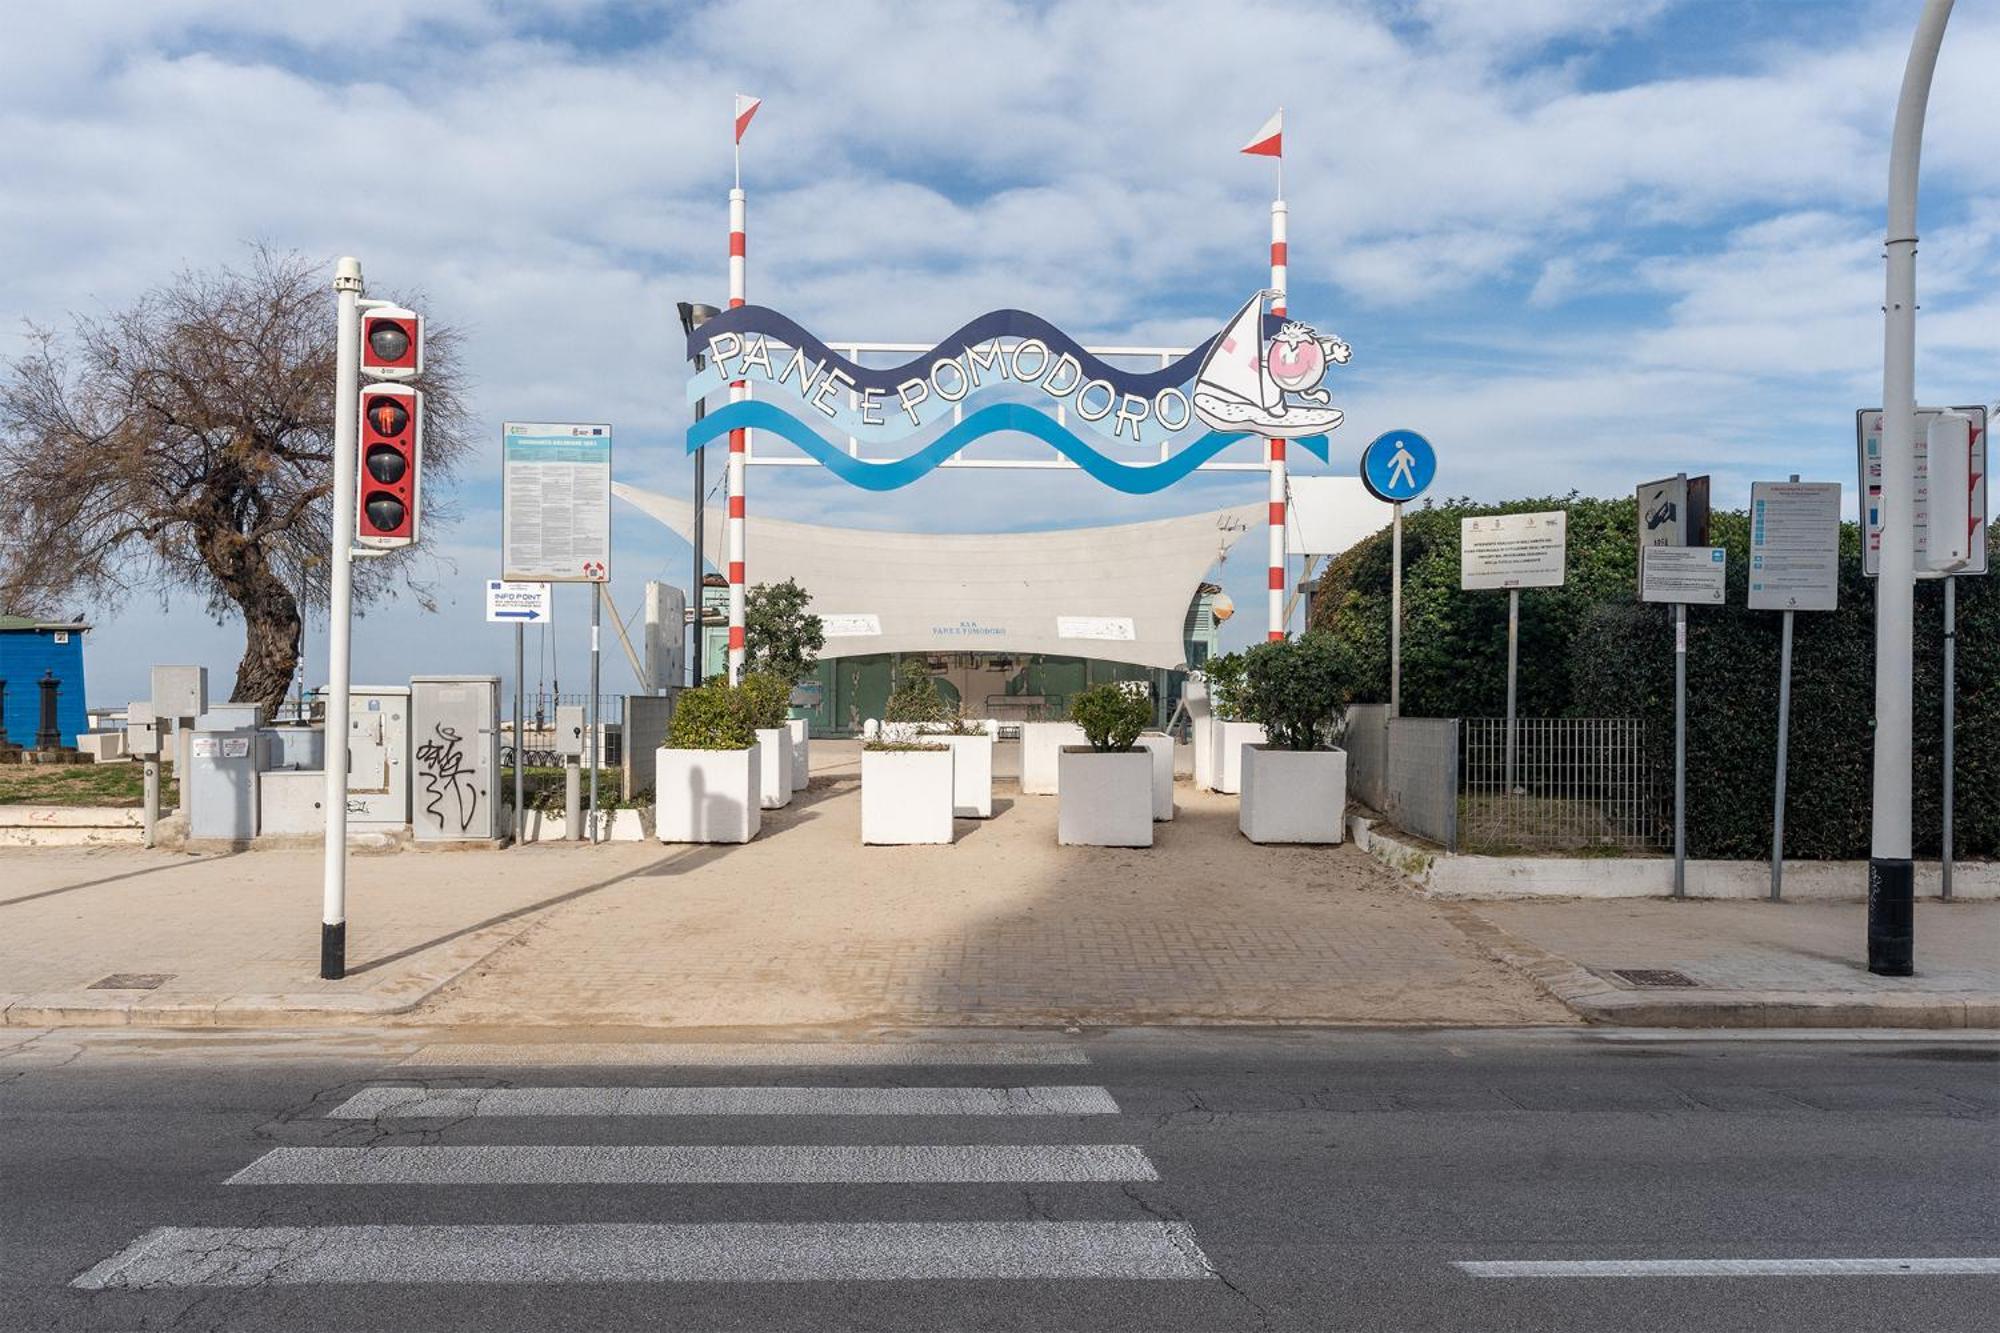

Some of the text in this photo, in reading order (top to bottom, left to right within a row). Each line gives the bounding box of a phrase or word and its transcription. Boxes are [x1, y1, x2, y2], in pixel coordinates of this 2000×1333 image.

[709, 331, 1192, 442] PANE E POMODORO
